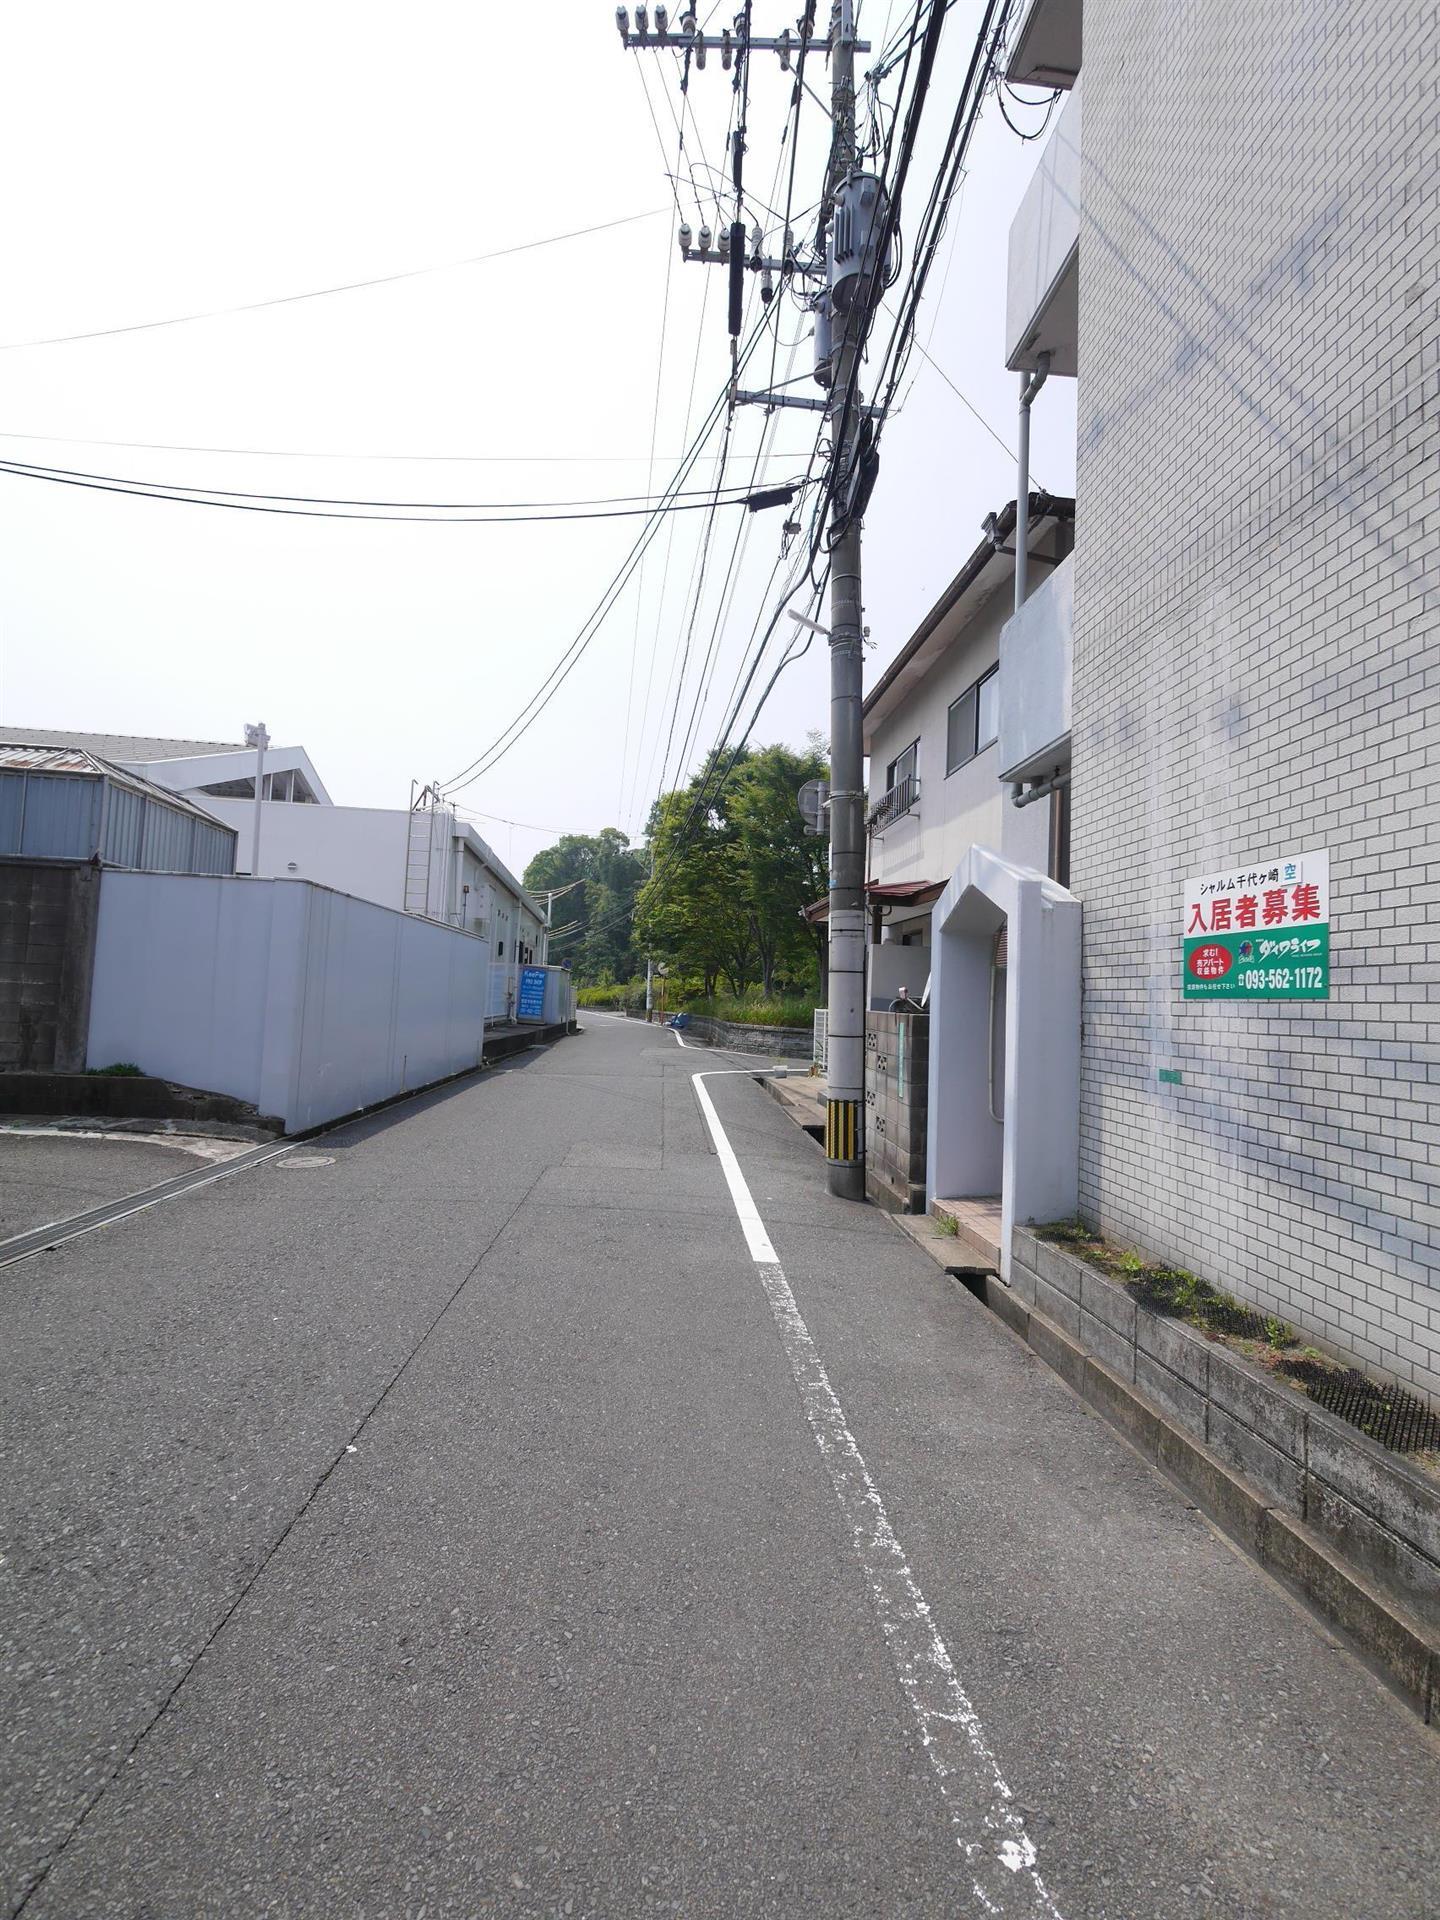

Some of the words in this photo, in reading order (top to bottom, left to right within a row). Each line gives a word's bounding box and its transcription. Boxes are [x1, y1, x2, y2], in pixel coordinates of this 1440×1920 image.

[1284, 863, 1296, 881] 空
[1187, 883, 1321, 934] 入居者募集
[1258, 937, 1321, 963] ダイワライフ
[1245, 966, 1322, 989] 093-562-1172
